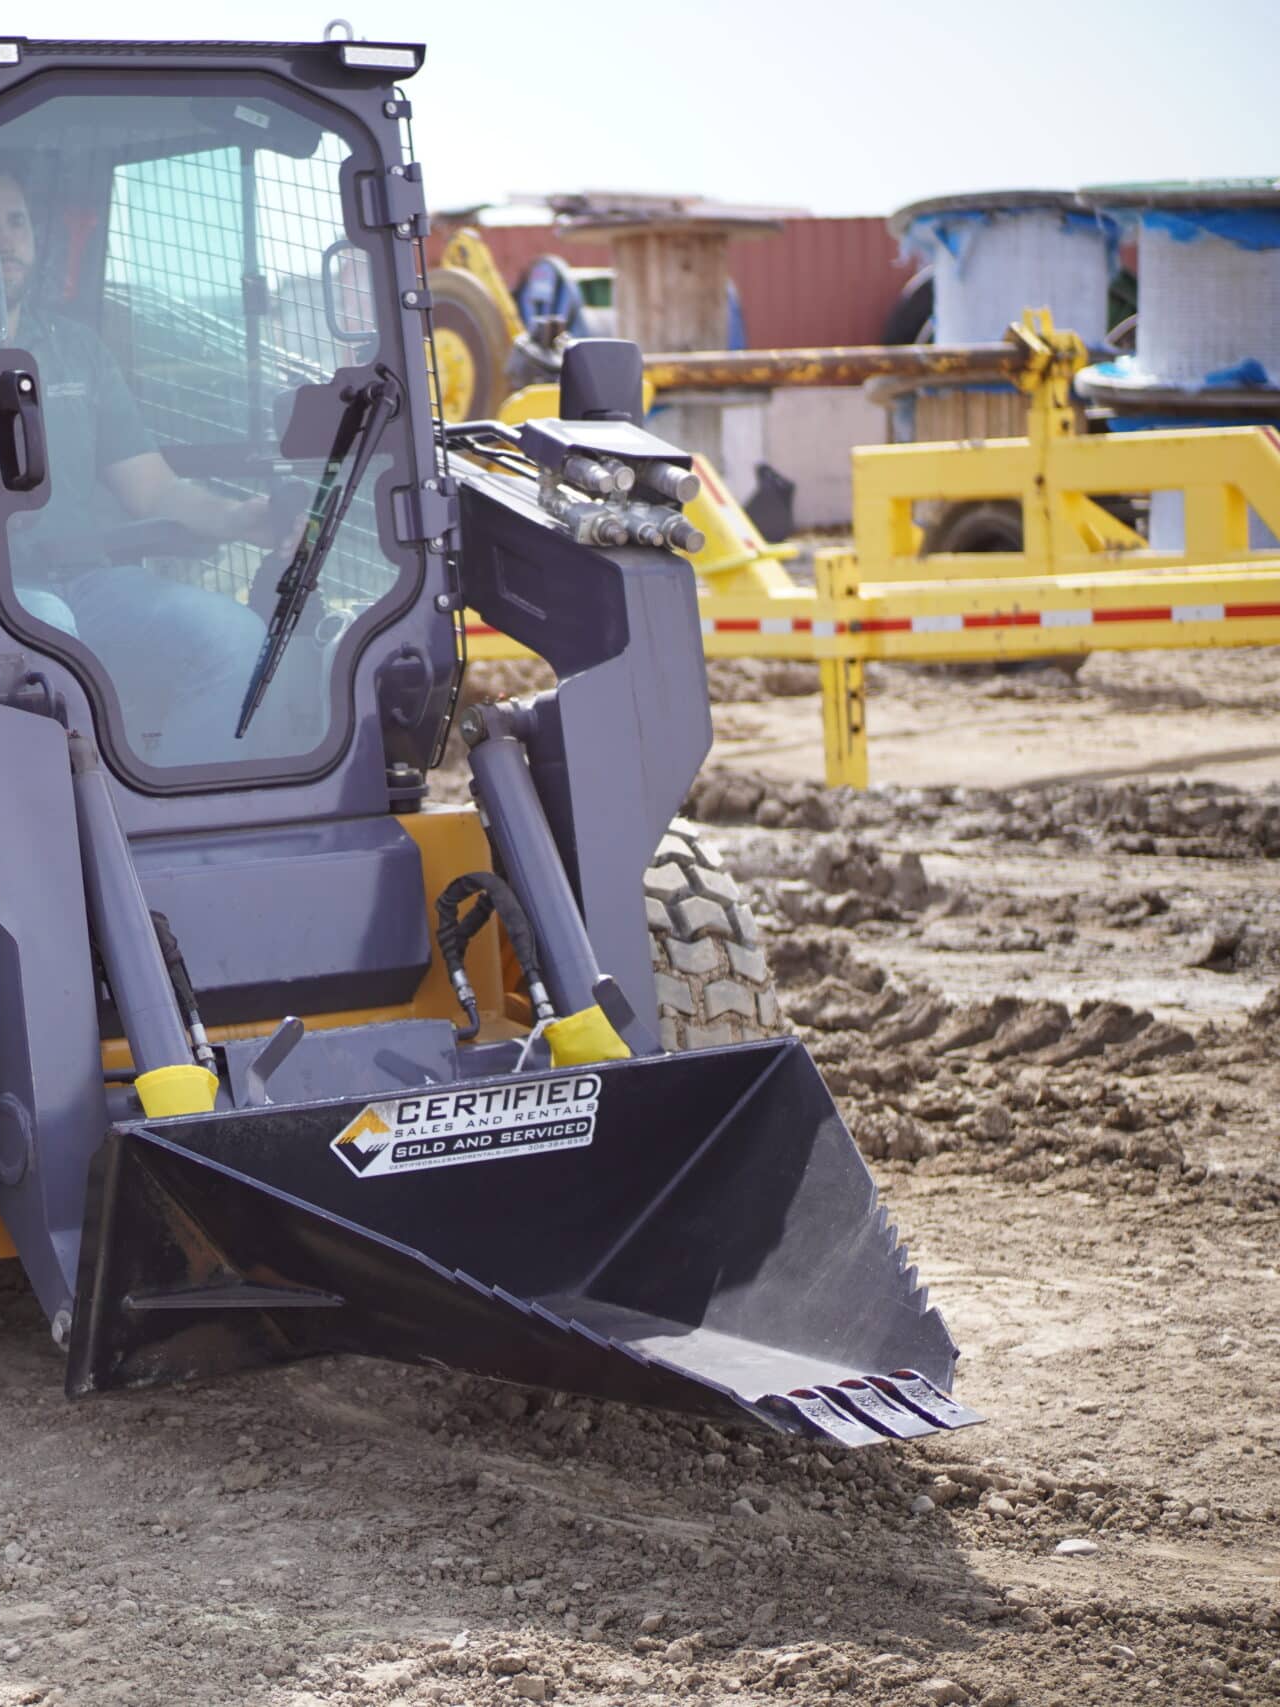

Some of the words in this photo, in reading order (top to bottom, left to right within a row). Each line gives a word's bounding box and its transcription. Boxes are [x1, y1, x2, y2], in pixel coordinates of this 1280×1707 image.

[397, 1078, 598, 1124] CERTIFIED
[394, 1123, 453, 1138] SALES
[466, 1116, 503, 1128] AND
[515, 1103, 595, 1121] RENTALS
[395, 1142, 445, 1158] SOLD
[453, 1134, 492, 1151] AND
[500, 1122, 588, 1143] SERVICED
